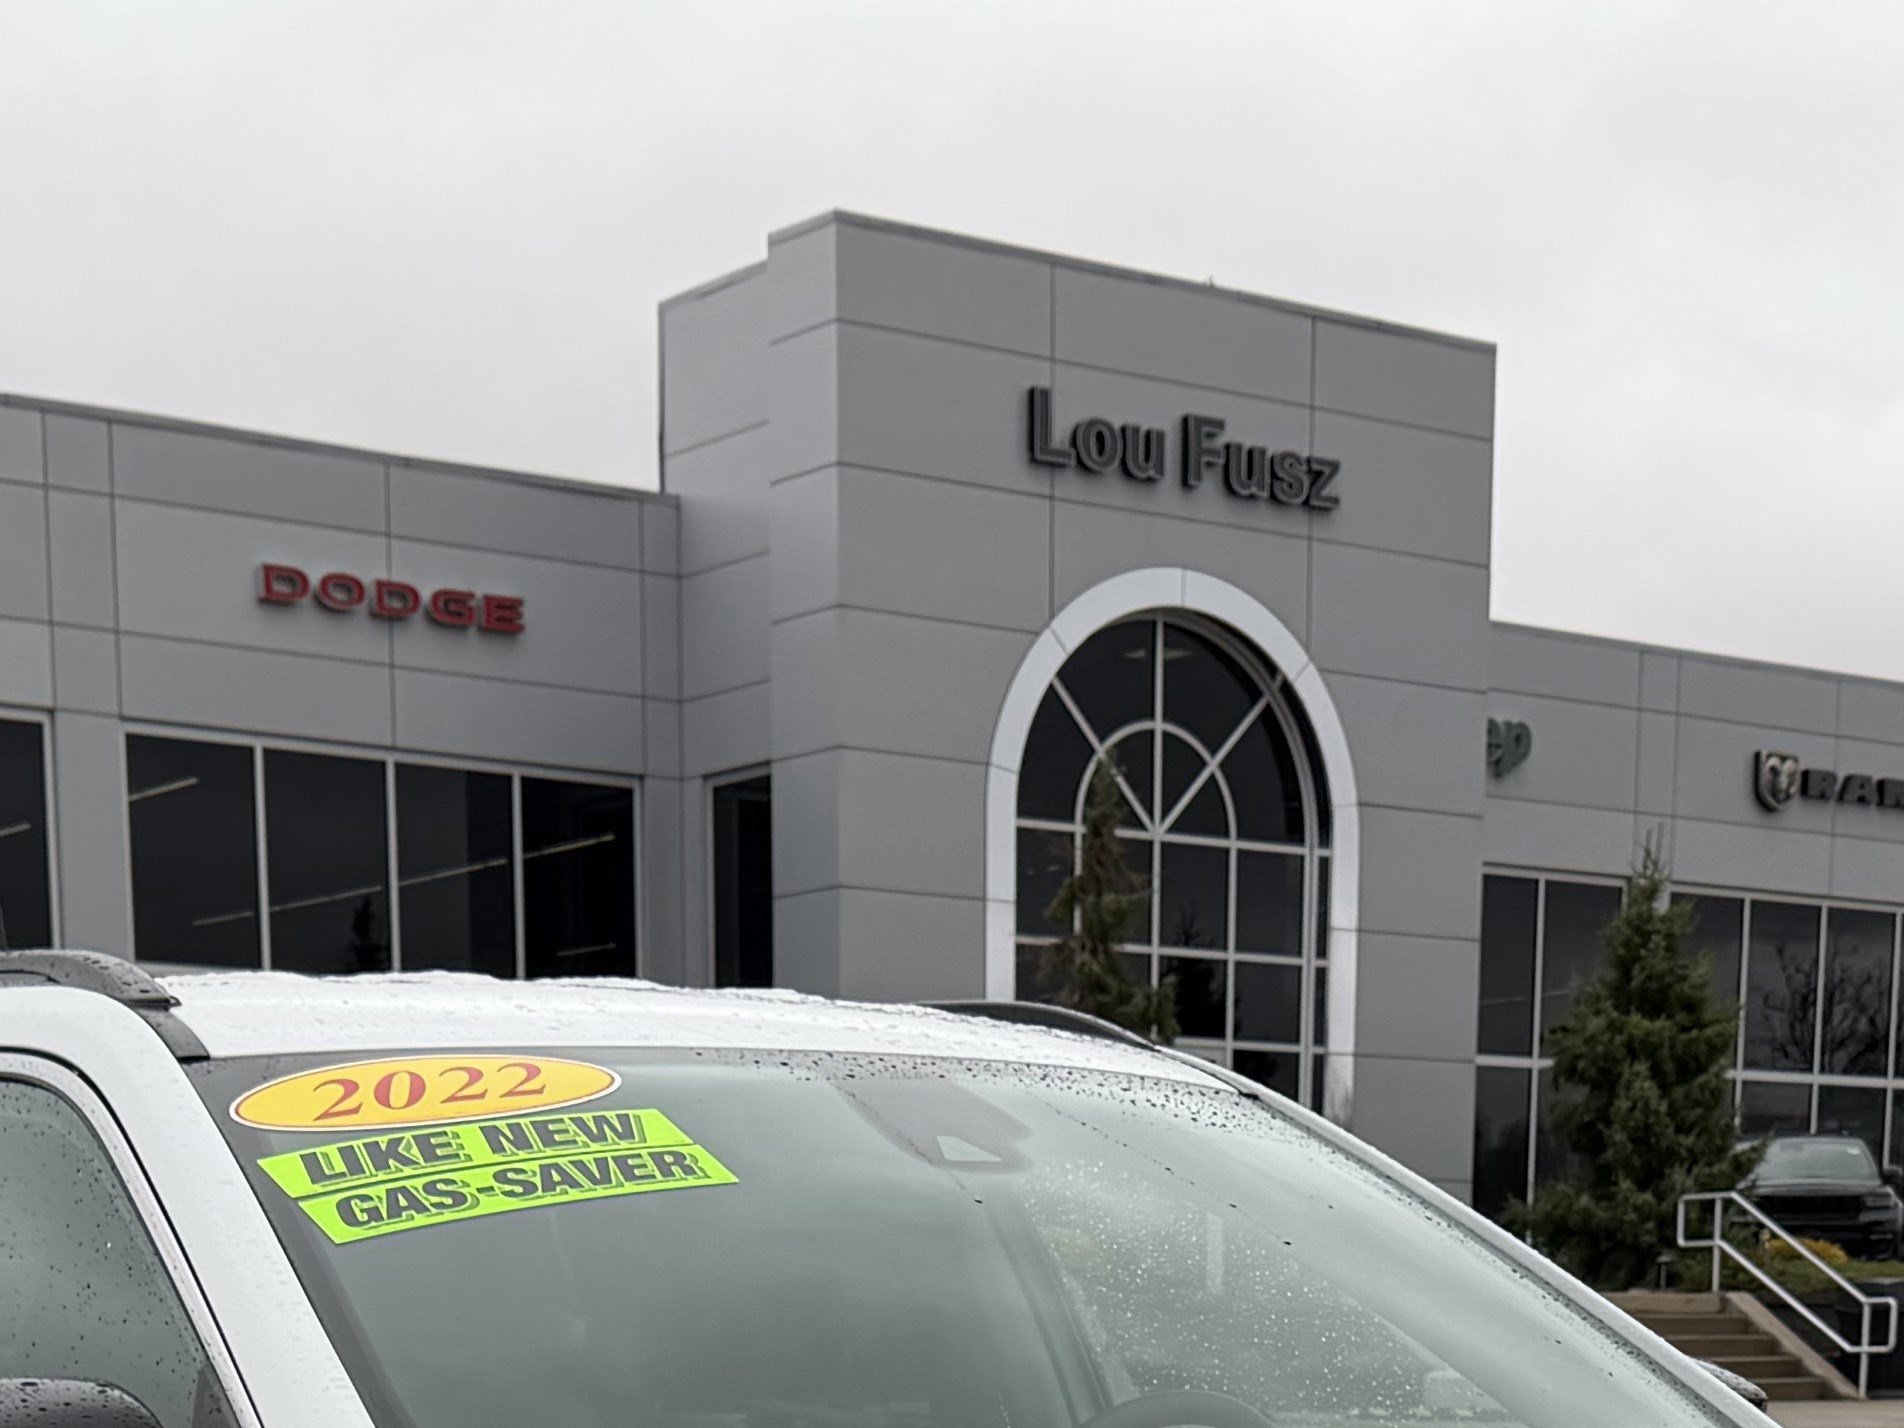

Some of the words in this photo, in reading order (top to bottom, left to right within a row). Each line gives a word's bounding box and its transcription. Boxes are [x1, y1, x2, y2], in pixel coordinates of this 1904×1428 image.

[1027, 385, 1166, 480] Lou
[1181, 412, 1341, 510] Fusz
[256, 562, 526, 634] DODGE
[311, 1061, 547, 1122] 2022
[298, 1130, 468, 1187] LIKE
[478, 1111, 647, 1155] NEW
[335, 1148, 711, 1231] GAS-SAVER
